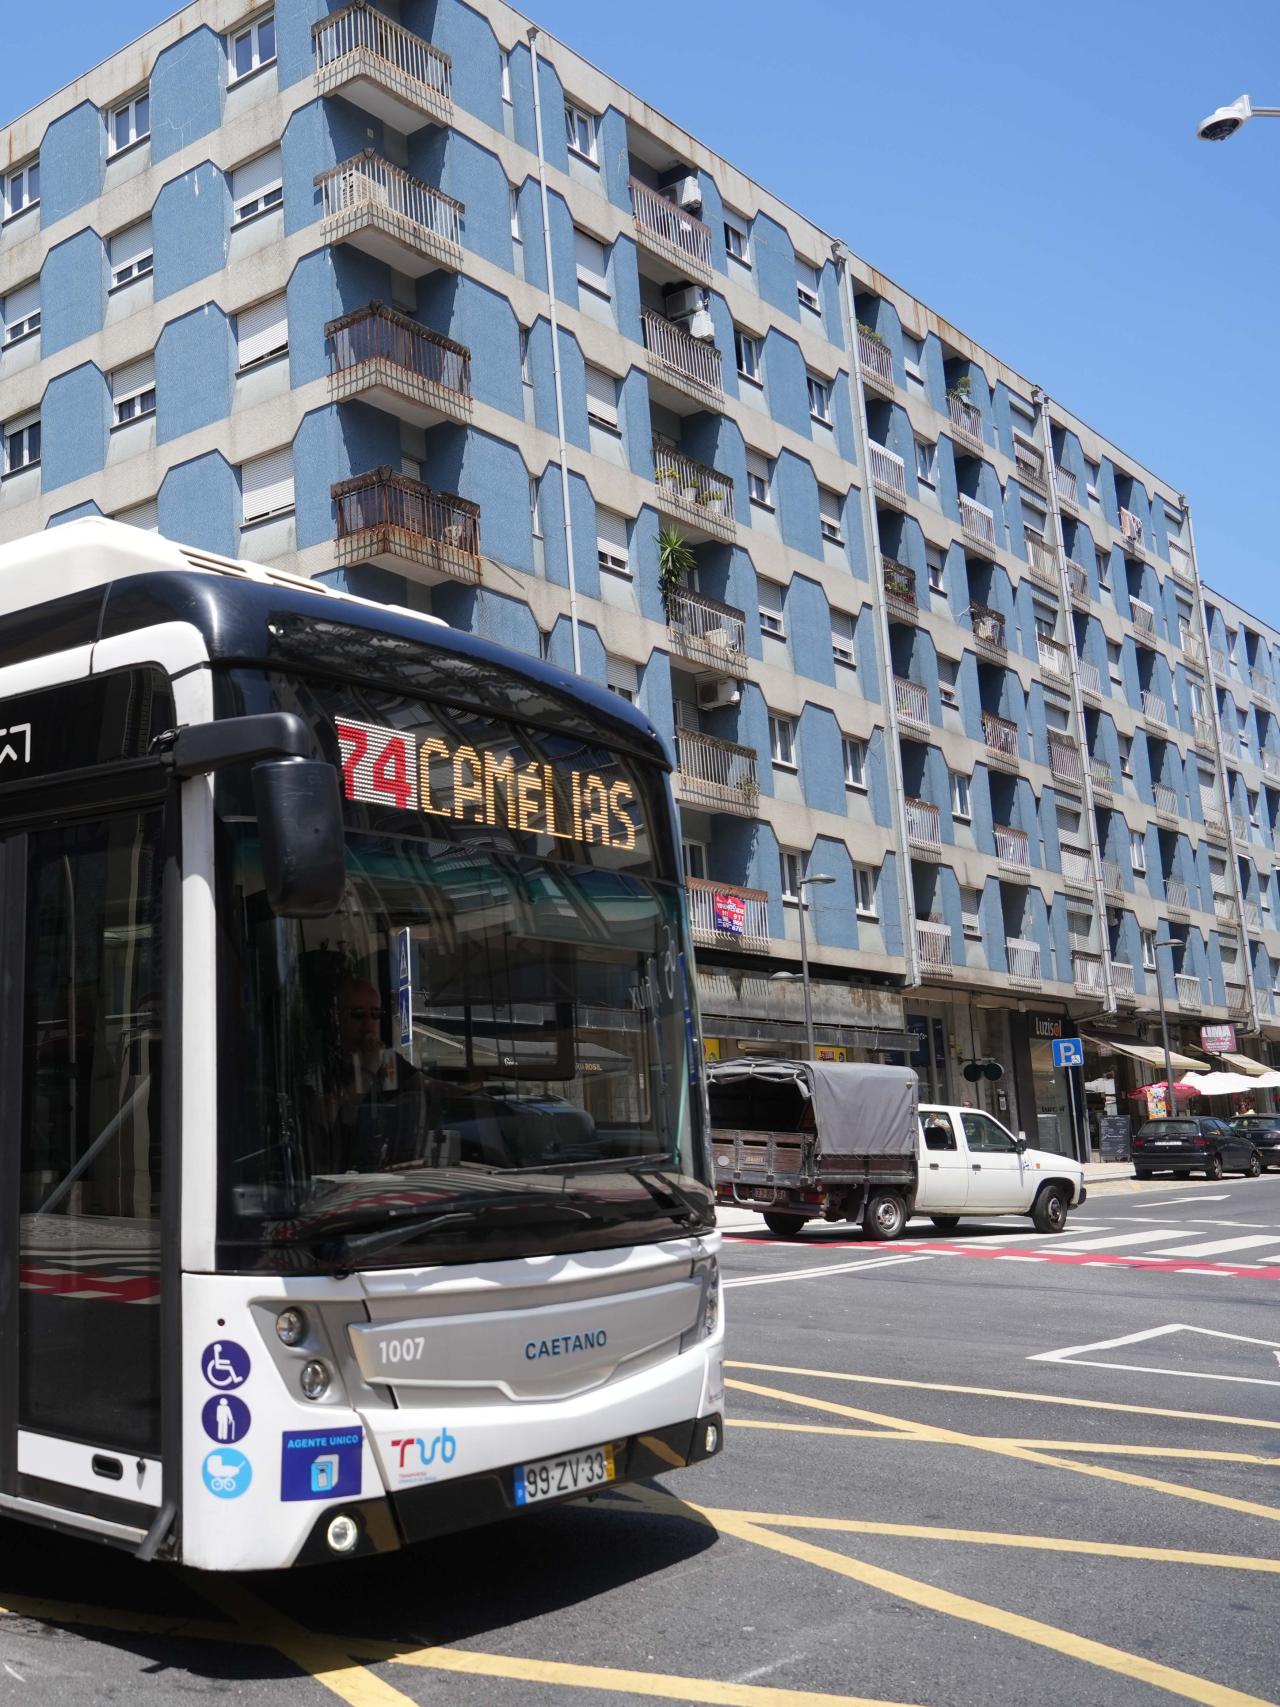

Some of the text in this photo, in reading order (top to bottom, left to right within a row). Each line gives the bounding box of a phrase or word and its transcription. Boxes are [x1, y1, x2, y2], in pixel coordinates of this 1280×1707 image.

[337, 724, 412, 809] 74
[379, 1329, 608, 1364] 1007 CAETANO
[287, 1434, 359, 1449] AGENTE ÚNICO
